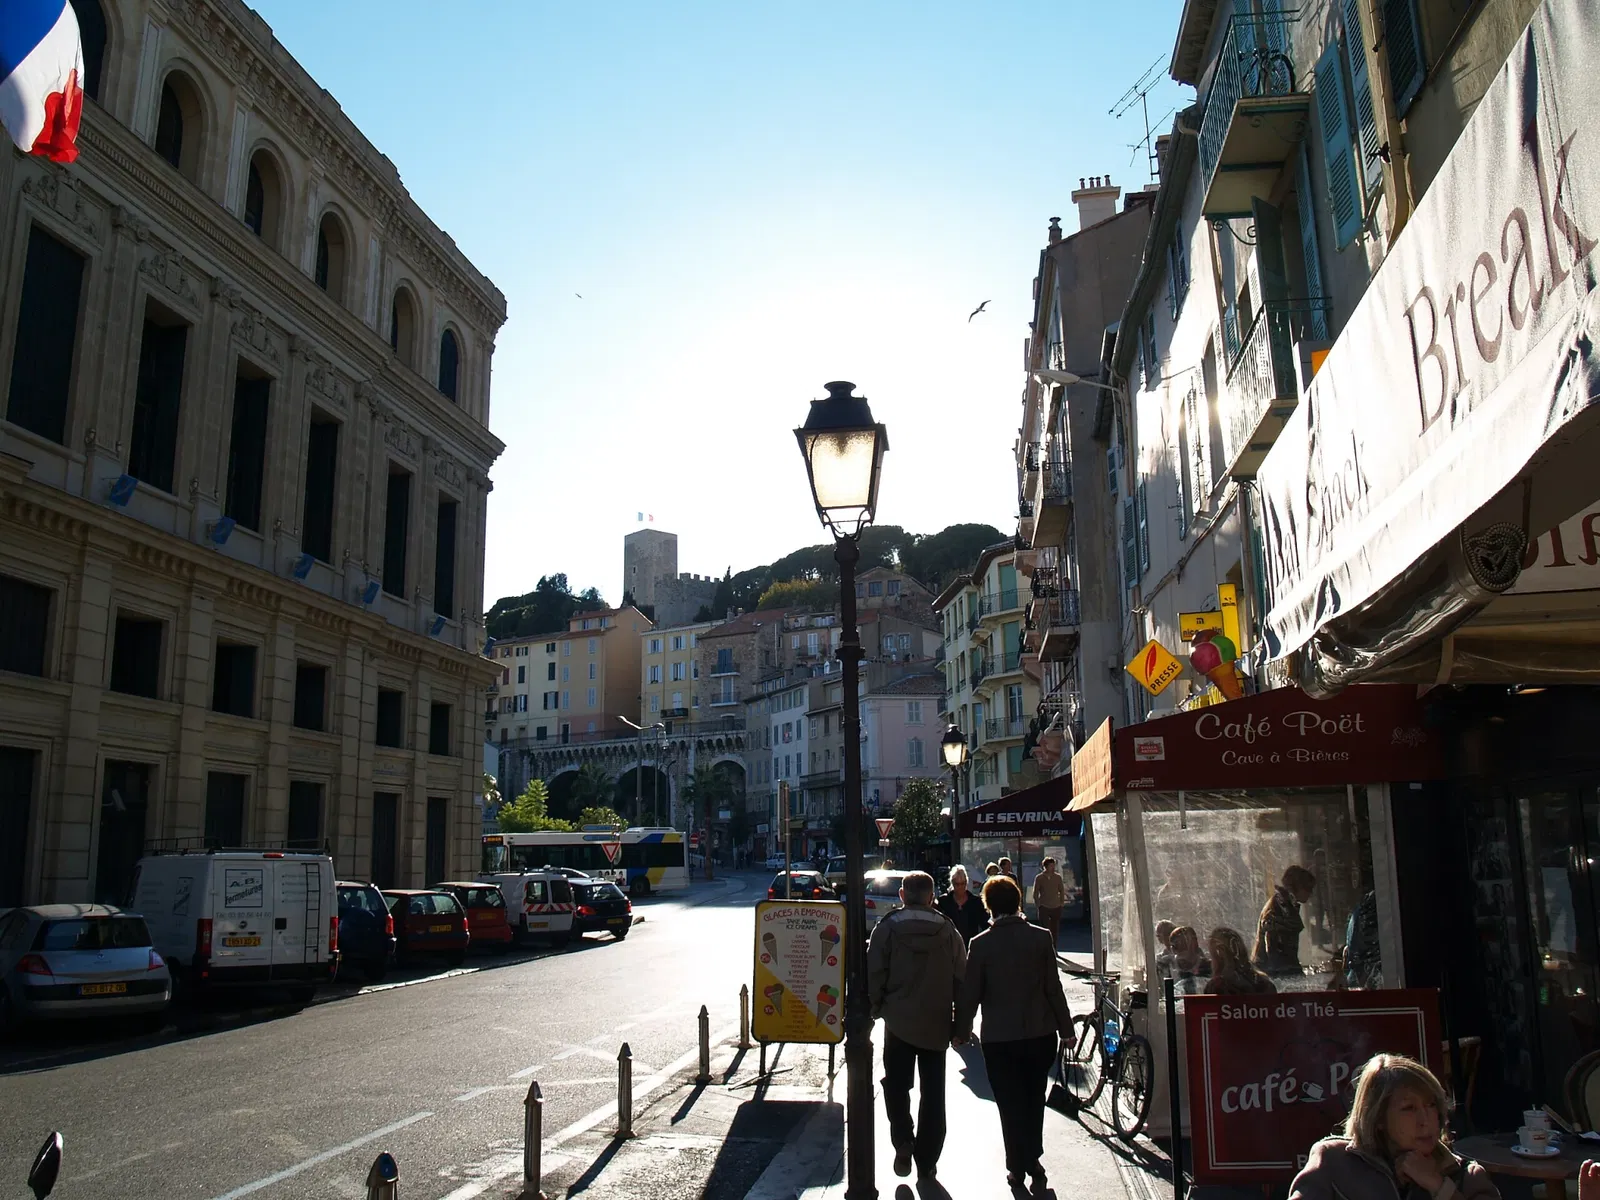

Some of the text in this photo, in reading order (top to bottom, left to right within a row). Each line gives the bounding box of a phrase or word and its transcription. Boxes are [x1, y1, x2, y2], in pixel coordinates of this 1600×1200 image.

[1403, 112, 1598, 438] Break
[1150, 661, 1179, 691] PRESSE
[1194, 711, 1366, 745] Café Poët
[1221, 748, 1349, 766] Cave à Bières
[977, 811, 1063, 823] LE SEVRINA
[973, 828, 1069, 837] Restaurant Pizzas
[763, 908, 840, 923] GLACES A EMPORTER
[1221, 1001, 1335, 1020] Salon de Thé
[1220, 1067, 1298, 1114] café
